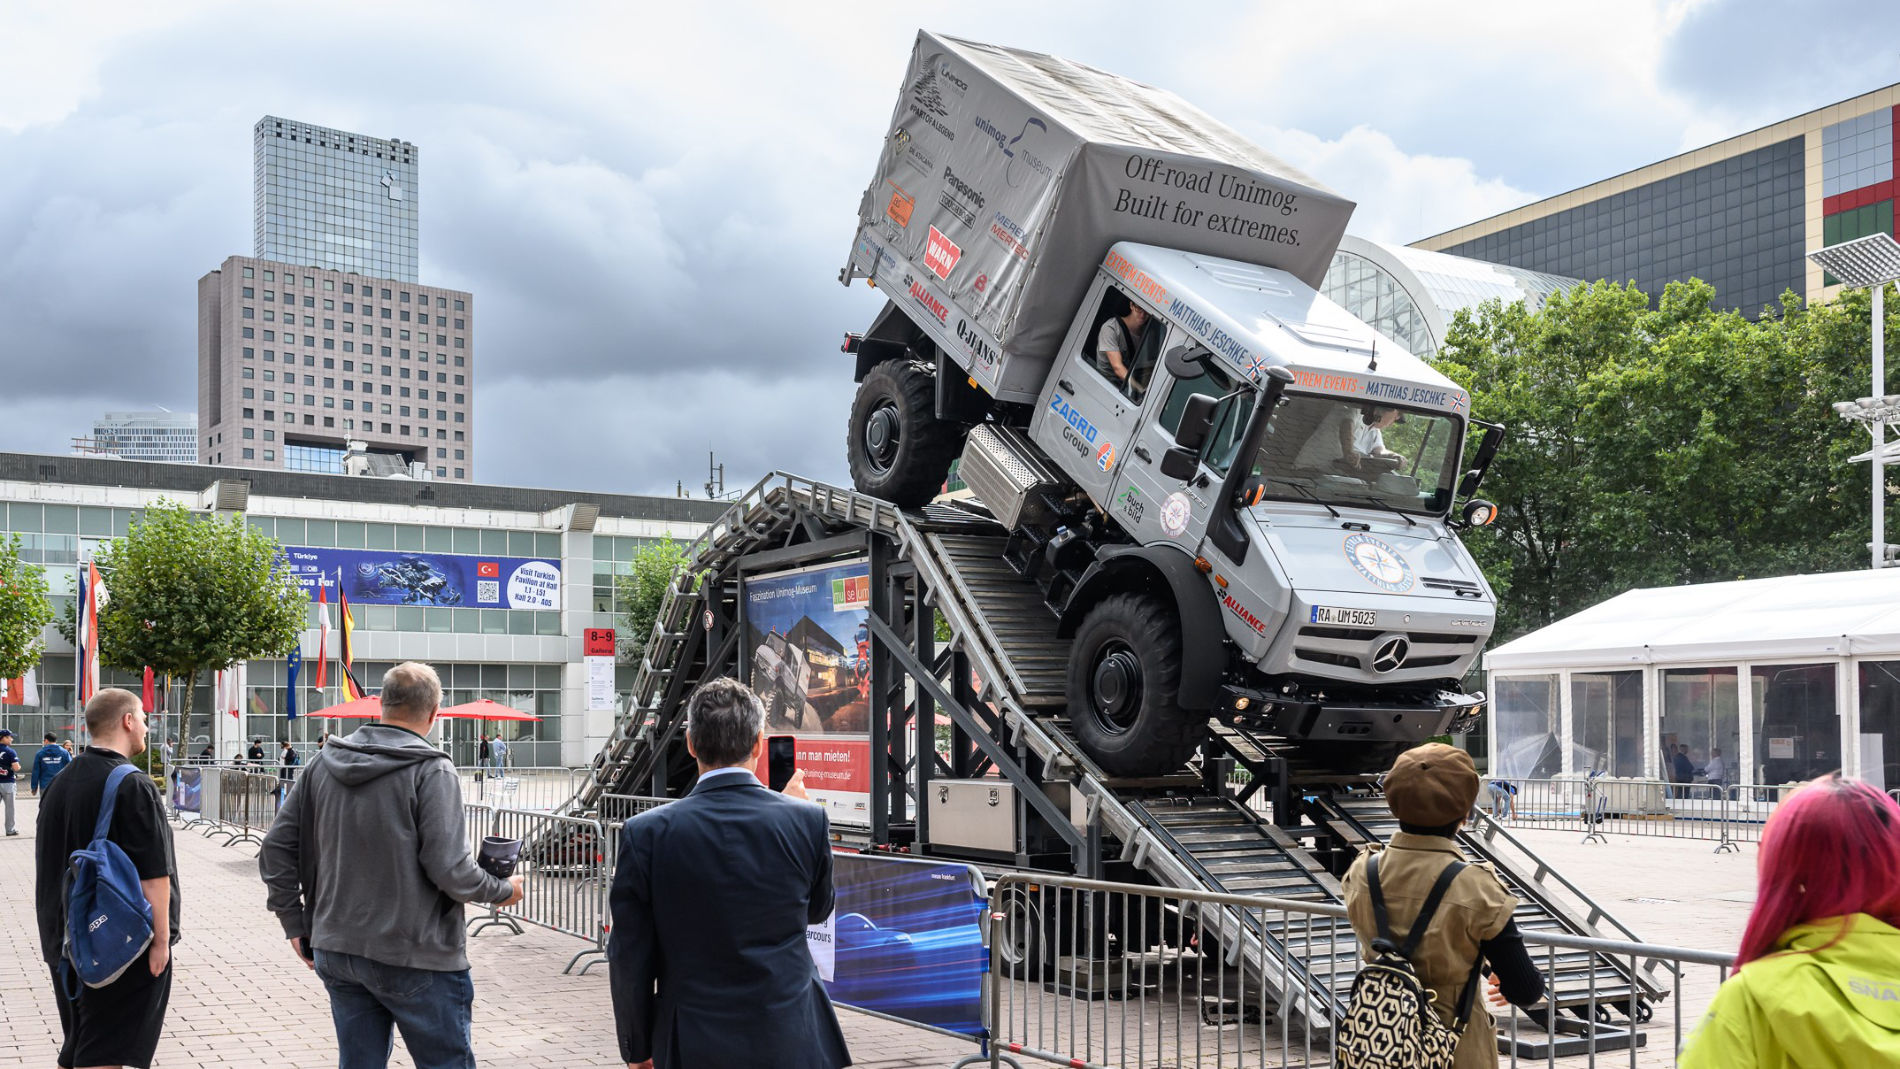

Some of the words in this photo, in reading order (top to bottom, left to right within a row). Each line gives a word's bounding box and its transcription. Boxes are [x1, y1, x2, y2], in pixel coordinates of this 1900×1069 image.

[941, 68, 968, 91] UNIMOG
[975, 115, 1006, 149] unimog
[1021, 149, 1053, 179] museum
[944, 166, 985, 209] Panasonic
[1125, 154, 1213, 194] Off-road
[1218, 174, 1298, 216] Unimog.
[995, 211, 1028, 242] MEREX
[1113, 189, 1168, 220] Built
[1171, 201, 1204, 227] for
[1207, 213, 1300, 246] extremes.
[928, 240, 954, 268] WARN
[990, 224, 1029, 260] MERTEC
[908, 281, 949, 321] ALLIANCE
[1105, 251, 1139, 284] EXTREM
[1133, 274, 1167, 304] EVENTS
[1169, 298, 1210, 337] MATTHIAS
[1207, 328, 1248, 365] JESCHKE
[1324, 375, 1358, 392] EVENTS
[1365, 381, 1408, 401] MATTHIAS
[1408, 388, 1447, 406] JESCHKE
[1050, 393, 1098, 444] ZAGRO
[1062, 426, 1089, 458] Group
[1127, 491, 1144, 513] buch
[1128, 507, 1142, 524] bild
[293, 552, 318, 561] Türkiye
[520, 568, 533, 577] Visit
[534, 570, 556, 581] Turkish
[749, 589, 775, 602] Faszination
[776, 584, 818, 600] Unimog-Museum
[1223, 595, 1266, 633] ALLIANCE
[1317, 606, 1330, 622] RA
[1337, 608, 1351, 624] UM
[1351, 610, 1375, 625] 5023
[808, 751, 823, 761] man
[824, 749, 851, 762] mieten!
[1848, 981, 1900, 1002] SNA
